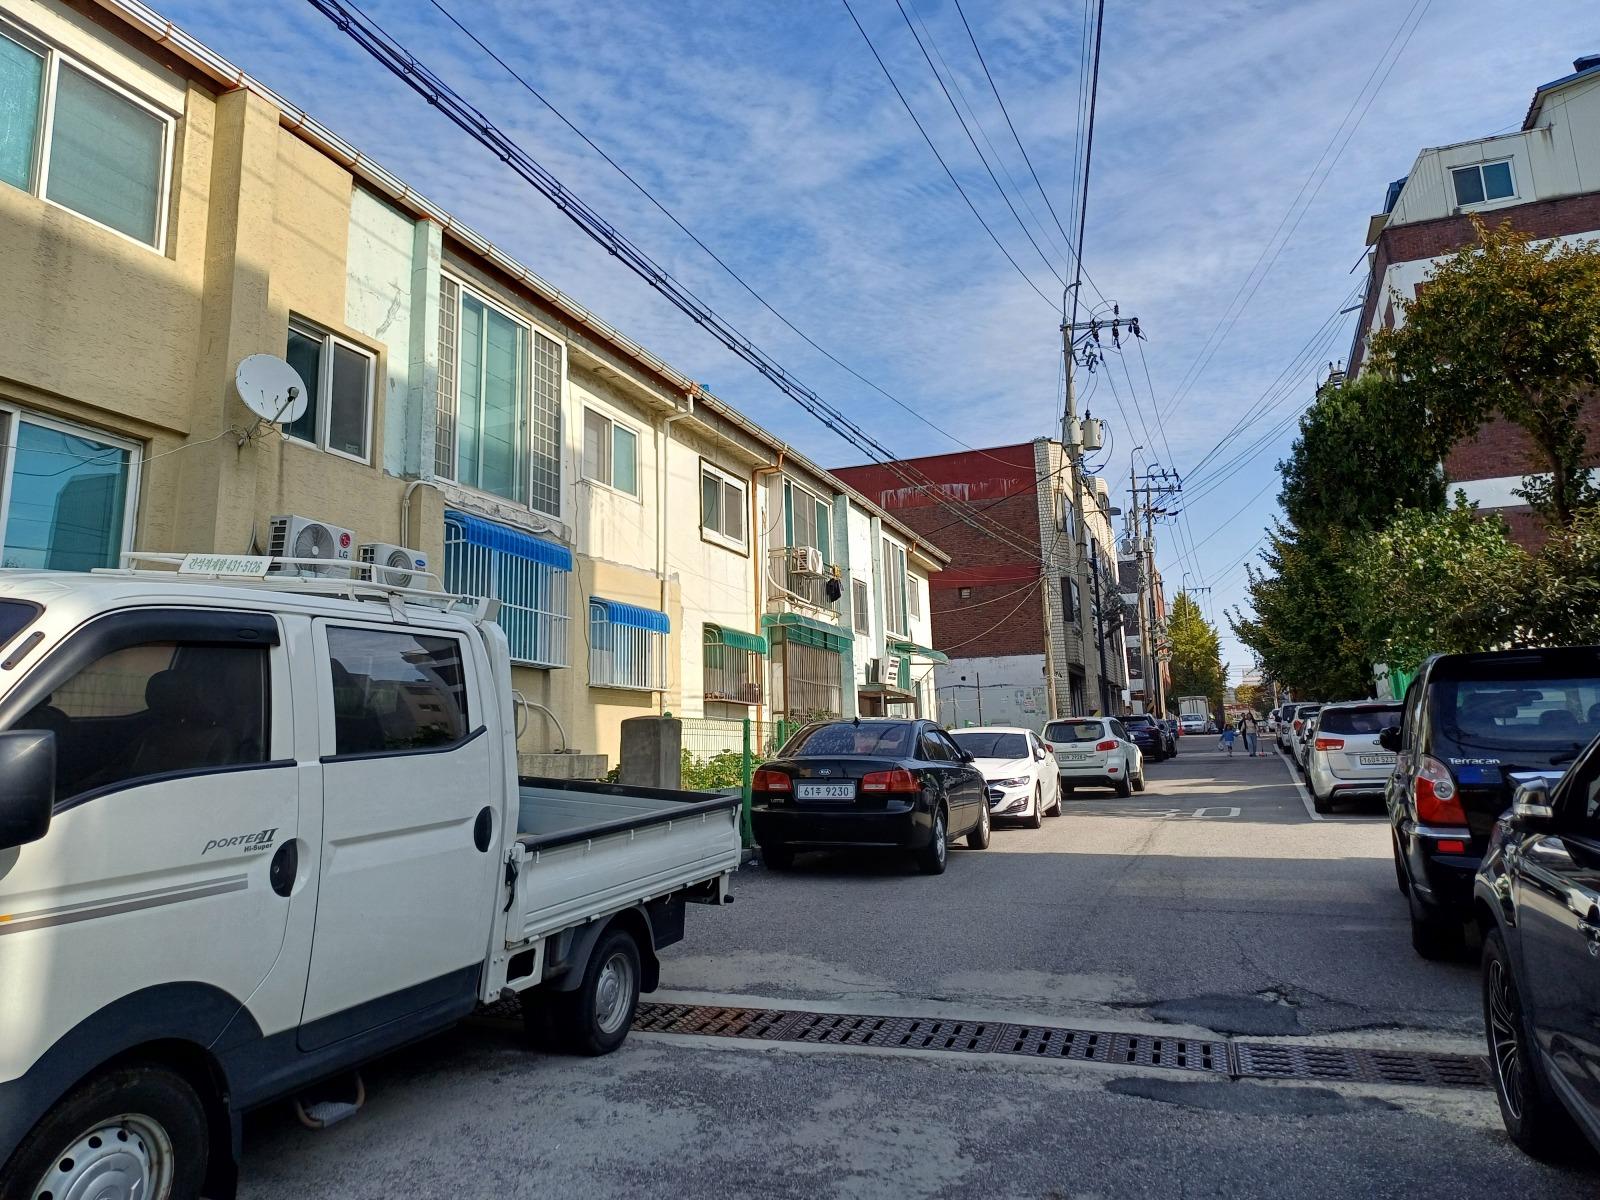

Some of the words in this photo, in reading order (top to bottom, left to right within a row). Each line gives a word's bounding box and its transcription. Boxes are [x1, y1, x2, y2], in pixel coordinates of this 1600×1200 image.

[338, 549, 348, 559] LG
[226, 559, 263, 574] 431-5126
[1448, 757, 1500, 765] Terracan
[826, 786, 849, 797] 9230
[244, 843, 273, 853] Hi-Super
